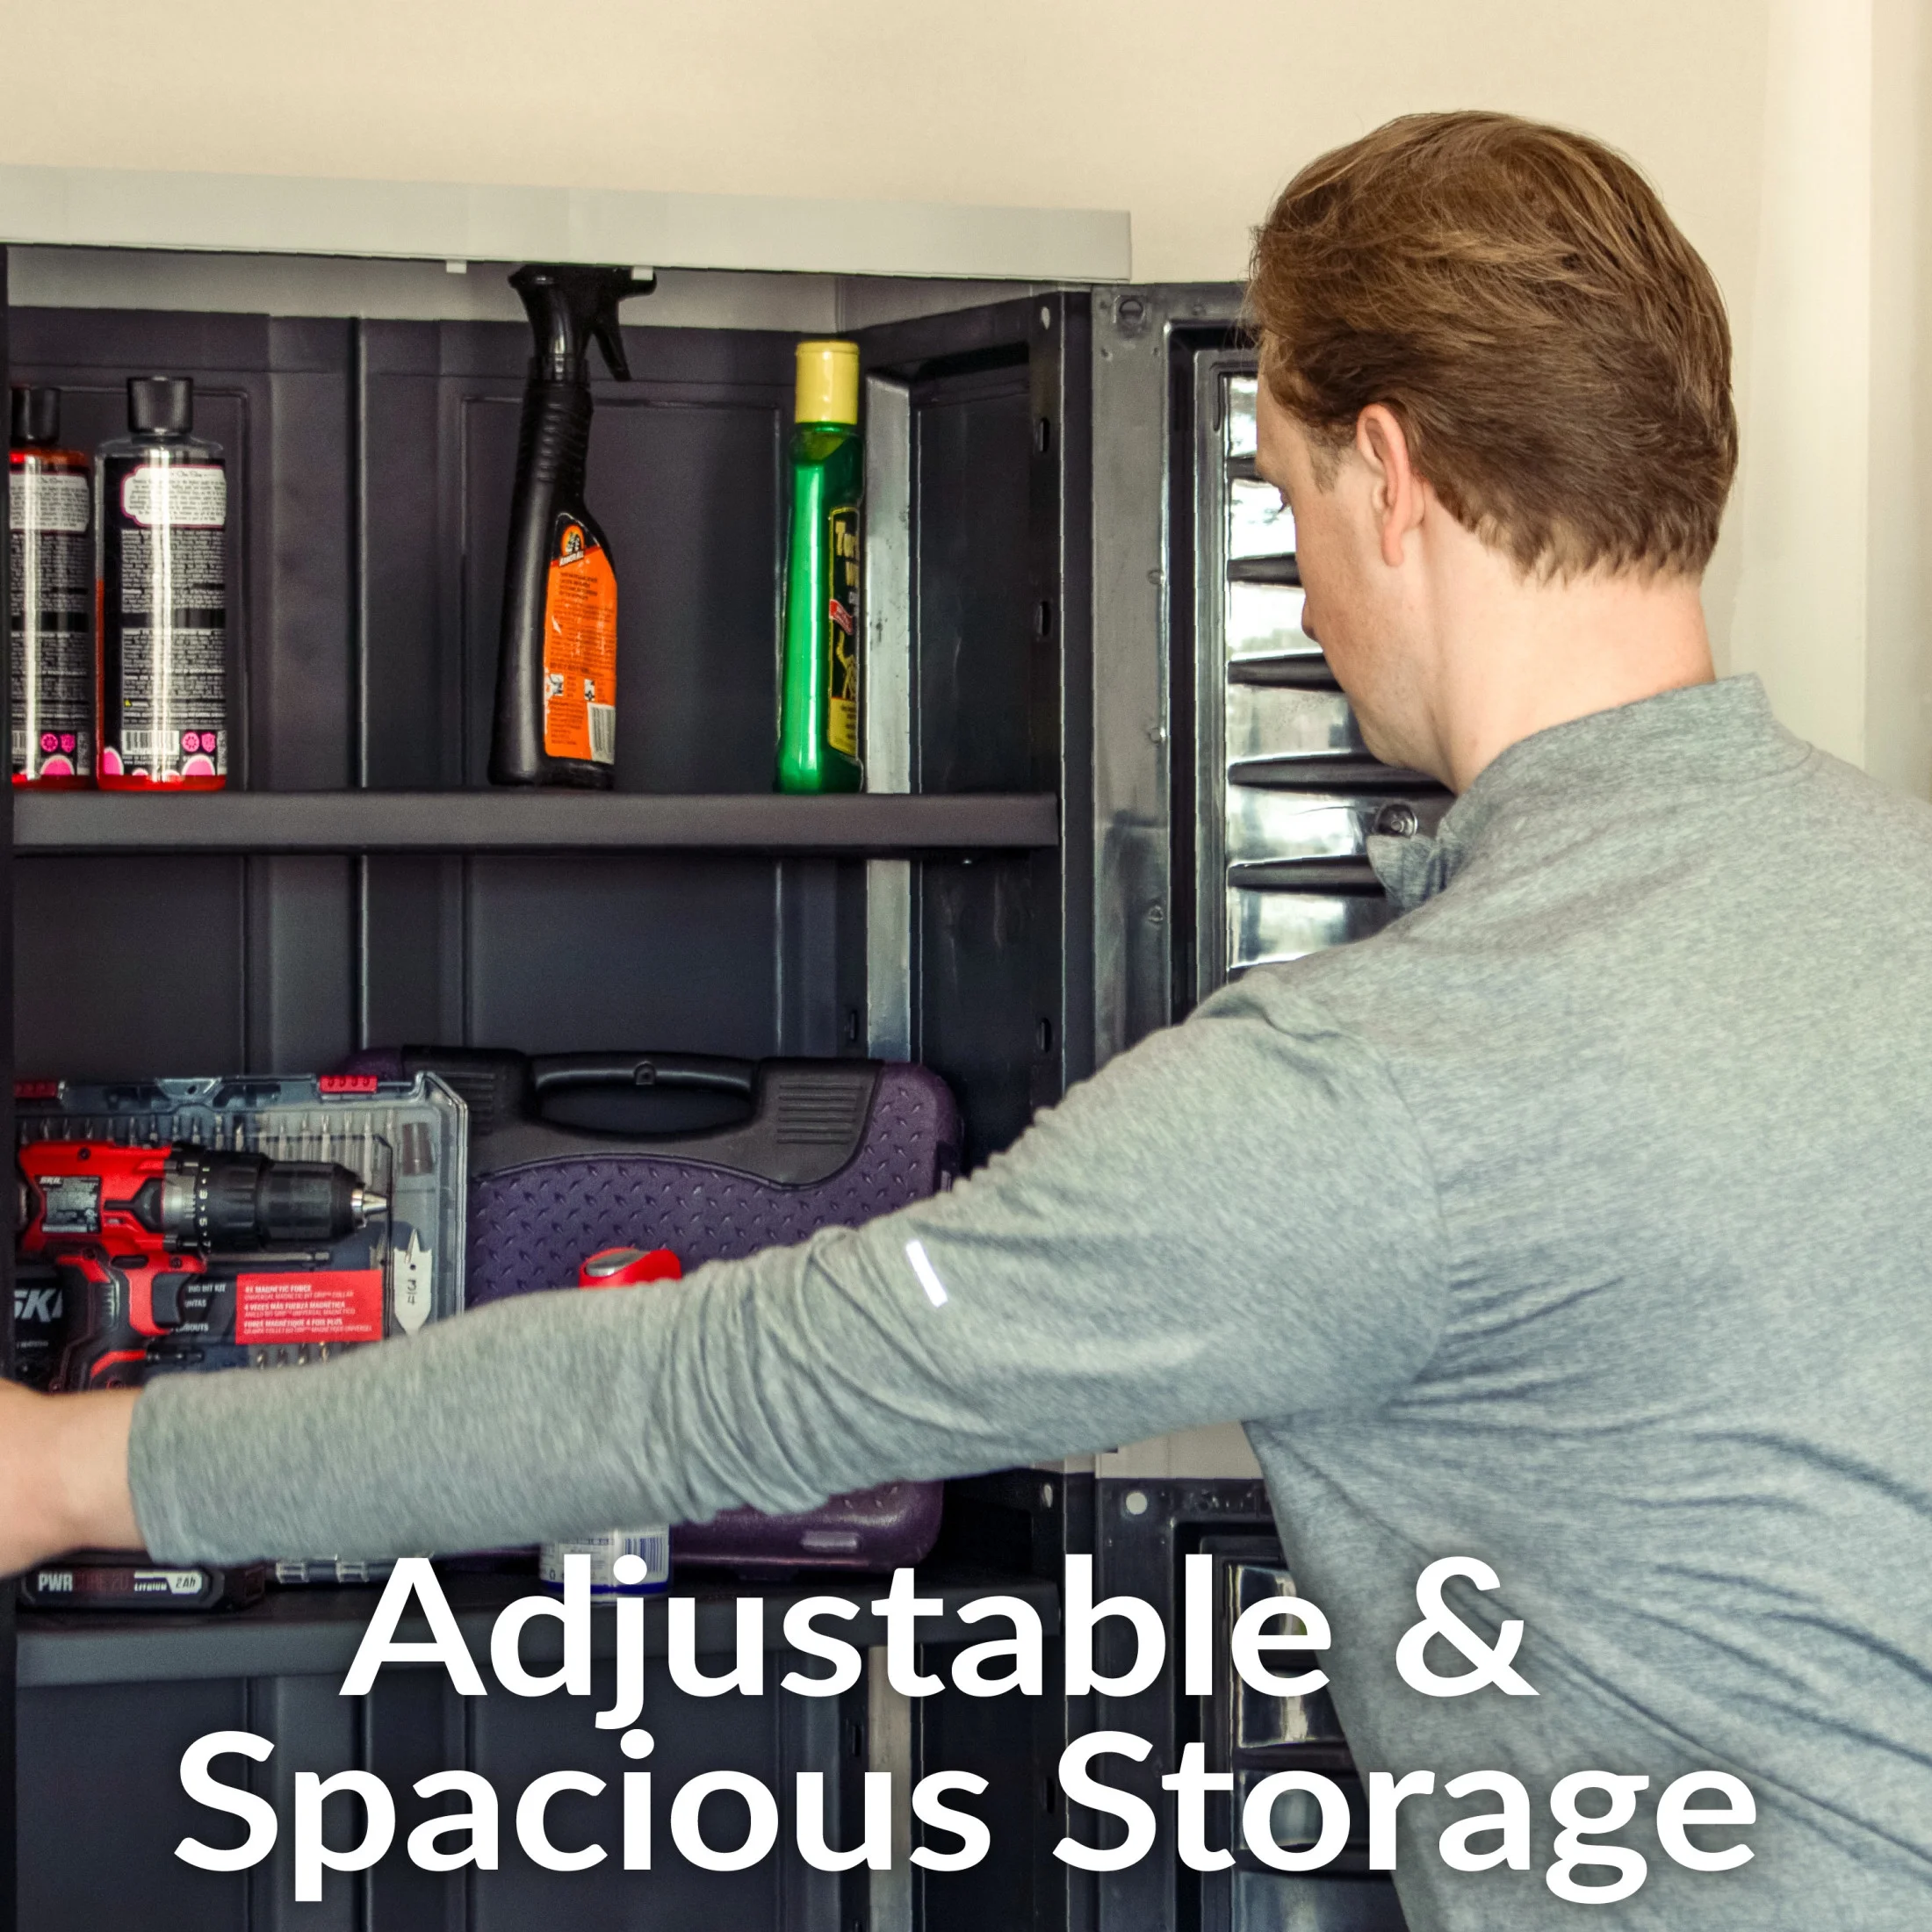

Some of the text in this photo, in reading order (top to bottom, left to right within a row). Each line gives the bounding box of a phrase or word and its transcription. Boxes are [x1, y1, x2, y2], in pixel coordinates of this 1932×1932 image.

[214, 1283, 227, 1293] KIT
[255, 1285, 290, 1294] MAGNETIC
[291, 1284, 312, 1294] FORCE
[249, 1302, 270, 1311] VECES
[285, 1301, 309, 1310] FUERZA
[327, 1317, 343, 1326] PLUS
[133, 1582, 168, 1592] LITHIUM
